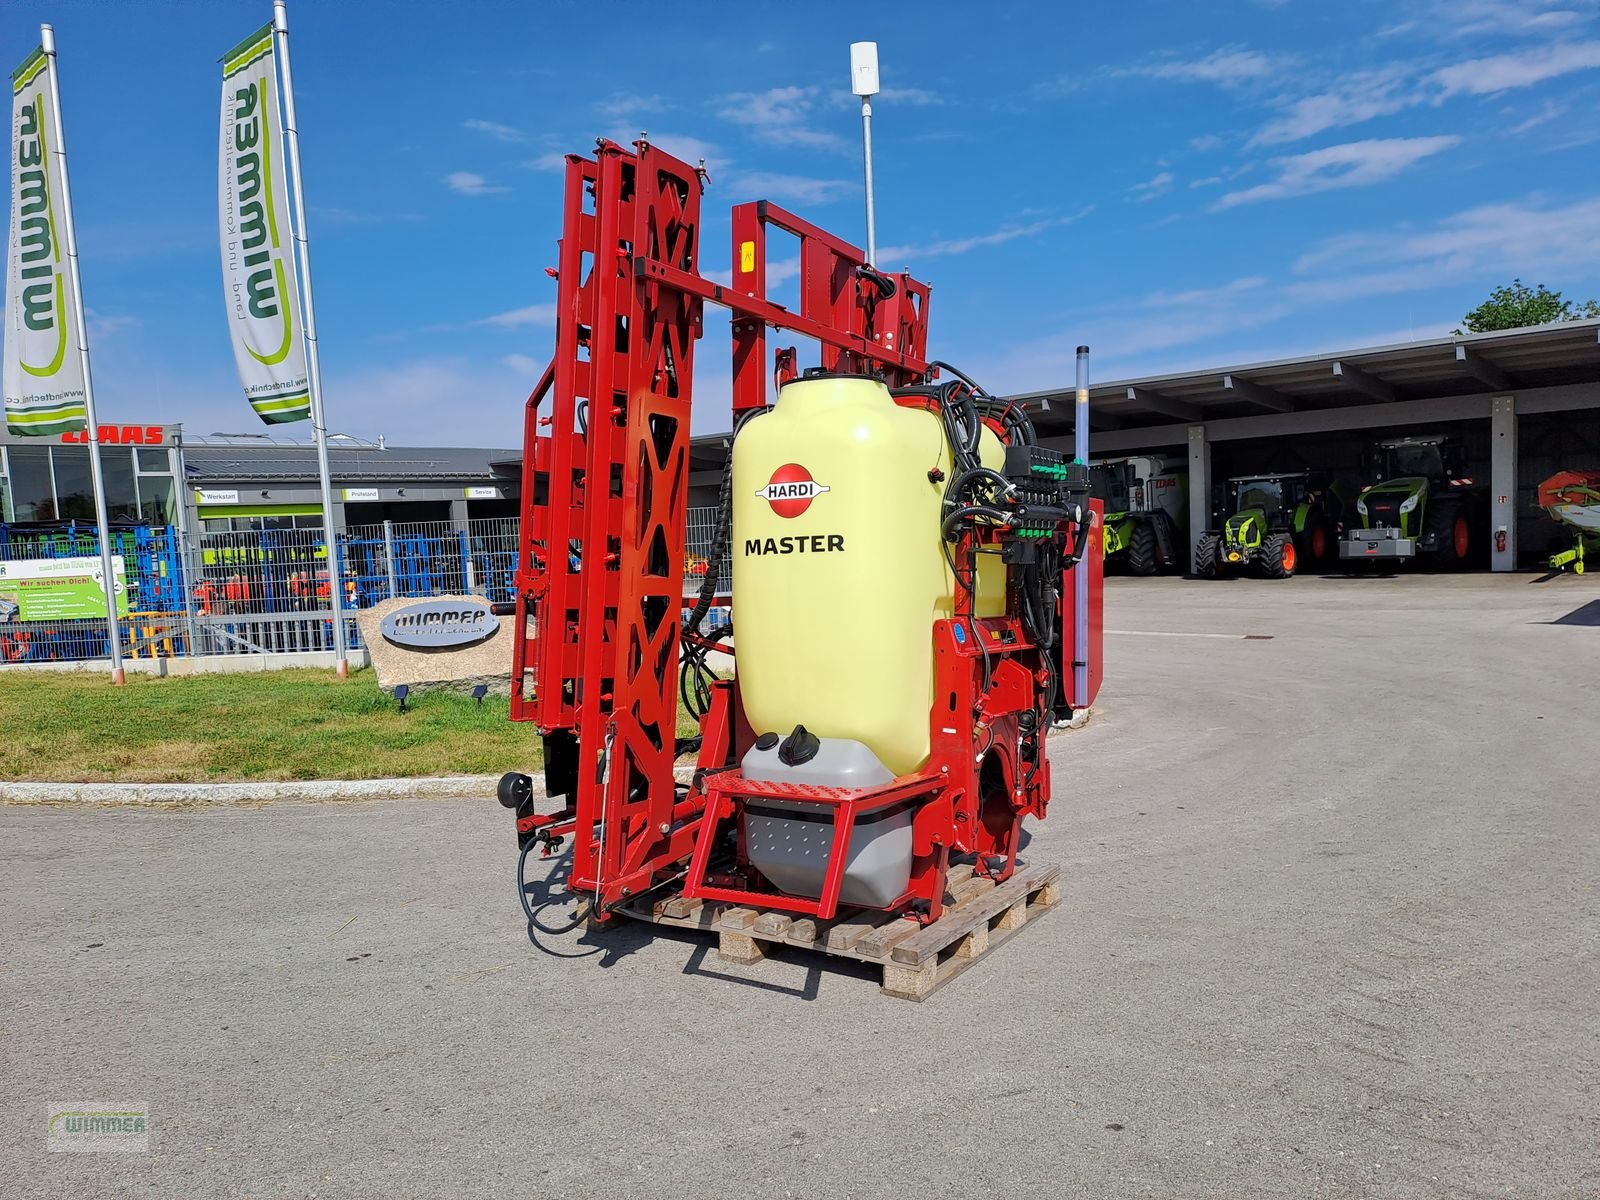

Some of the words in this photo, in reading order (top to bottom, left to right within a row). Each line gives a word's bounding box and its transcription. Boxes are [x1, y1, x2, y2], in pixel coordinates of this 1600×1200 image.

[768, 483, 814, 498] HARDI
[745, 534, 845, 556] MASTER
[395, 610, 486, 627] WIMMER
